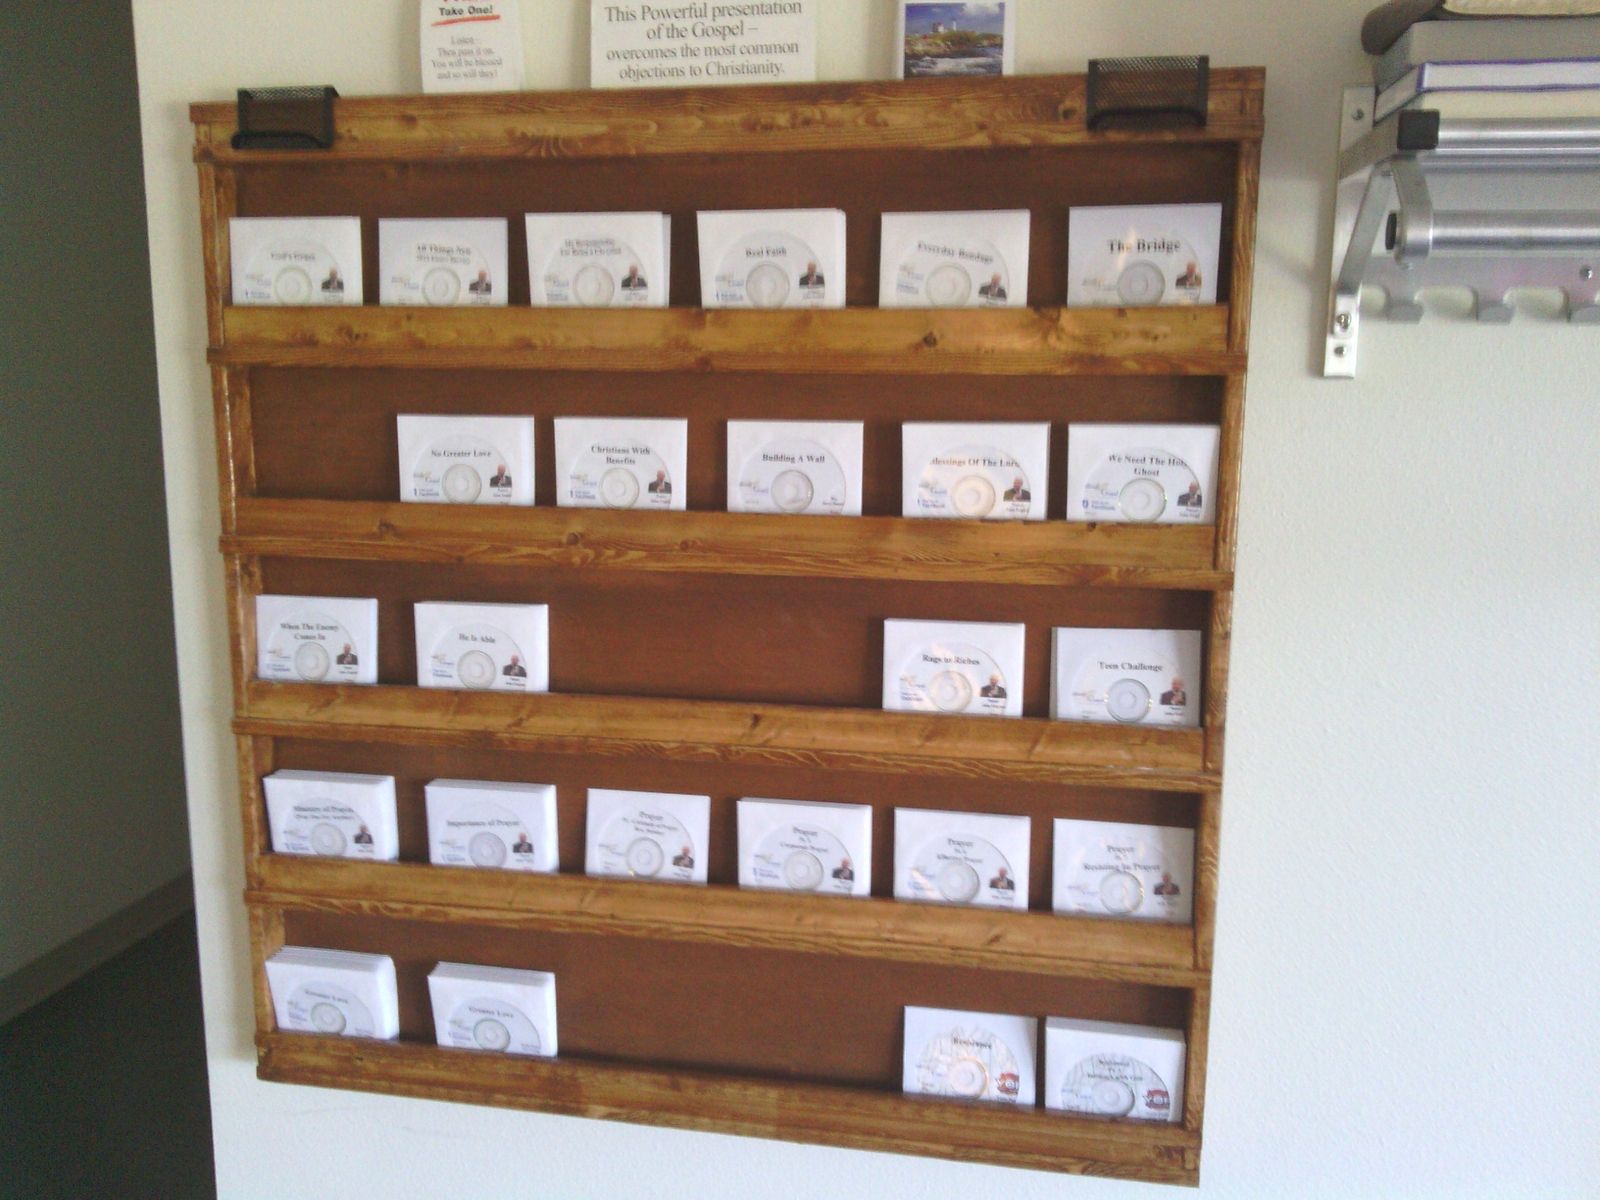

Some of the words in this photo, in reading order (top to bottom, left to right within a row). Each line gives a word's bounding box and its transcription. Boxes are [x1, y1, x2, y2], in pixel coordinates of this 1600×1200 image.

[438, 7, 464, 16] Take
[467, 5, 493, 14] One!
[604, 6, 637, 22] This
[641, 2, 708, 20] Powerful
[711, 0, 802, 21] presentation
[646, 24, 664, 39] of
[666, 23, 688, 39] the
[692, 20, 745, 40] Gospel
[606, 46, 677, 61] overcomes
[680, 43, 700, 58] the
[703, 43, 736, 57] most
[739, 42, 799, 55] common
[619, 63, 686, 82] objections
[689, 64, 702, 77] to
[705, 59, 785, 77] Christianity.
[1107, 239, 1132, 253] The
[1136, 238, 1181, 254] Bridge
[443, 449, 471, 457] Greater
[473, 449, 492, 457] Love
[591, 445, 629, 454] Christians
[631, 446, 651, 455] With
[606, 456, 636, 465] Benefits
[762, 453, 795, 463] Building
[806, 455, 825, 463] Wall
[968, 457, 979, 466] Of
[982, 457, 997, 467] The
[1125, 455, 1146, 464] Need
[1150, 456, 1165, 466] The
[1097, 661, 1119, 670] Teen
[1121, 661, 1163, 671] Challenge
